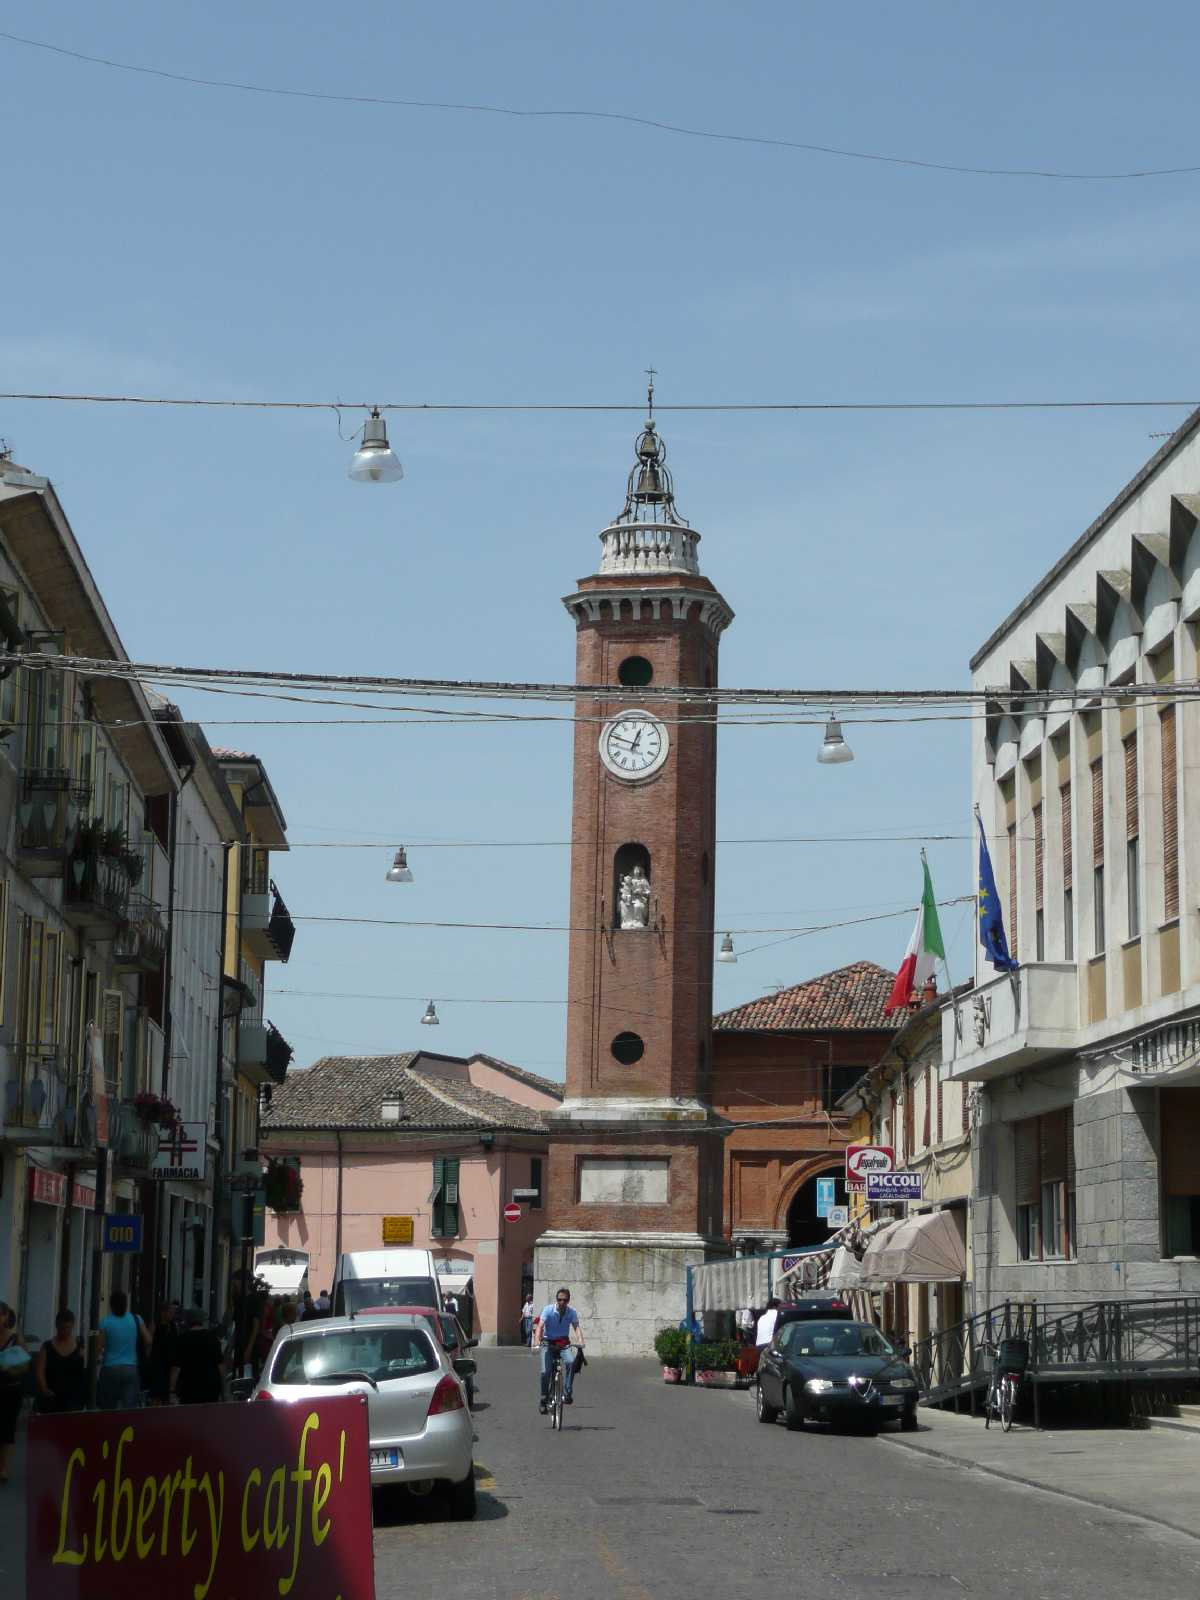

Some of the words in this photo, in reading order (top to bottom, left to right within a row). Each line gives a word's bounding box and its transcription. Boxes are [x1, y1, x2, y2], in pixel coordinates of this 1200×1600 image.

[153, 1168, 200, 1177] FARMACIA
[869, 1175, 920, 1187] PICCOLI
[52, 1426, 225, 1600] Liberty
